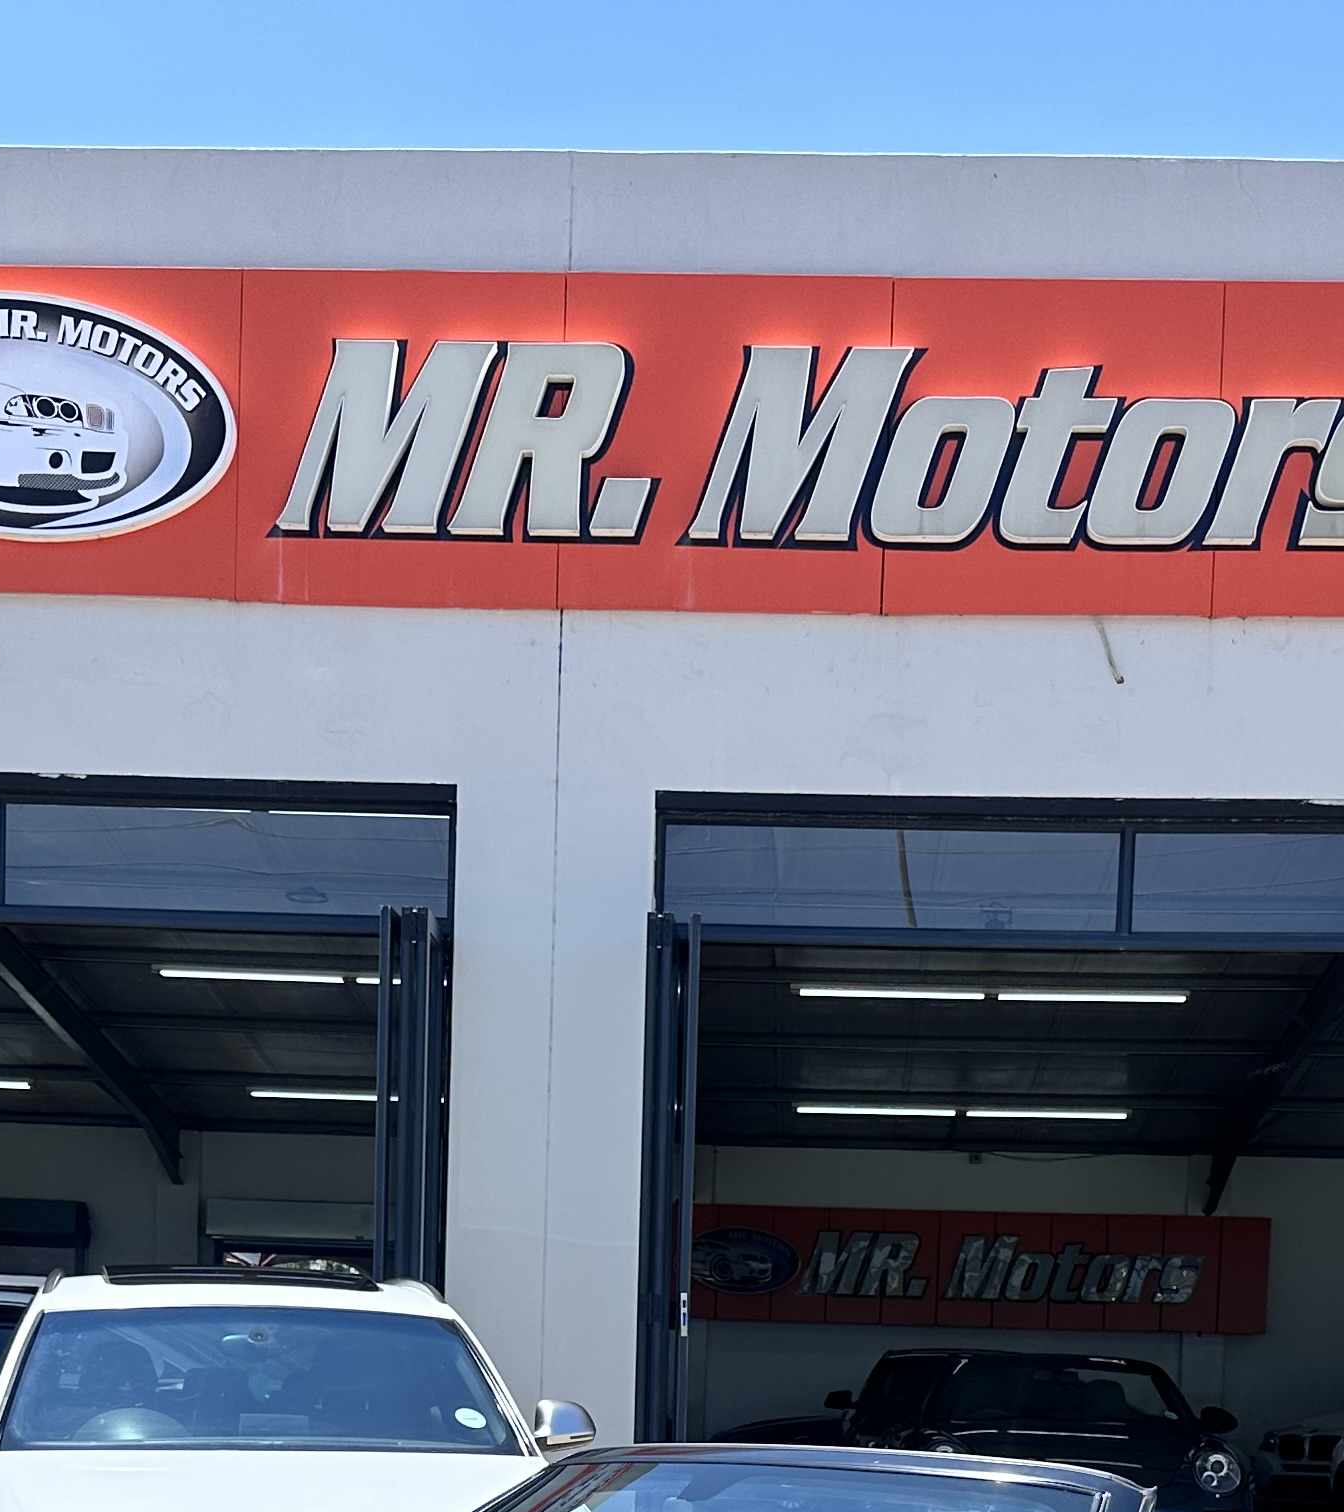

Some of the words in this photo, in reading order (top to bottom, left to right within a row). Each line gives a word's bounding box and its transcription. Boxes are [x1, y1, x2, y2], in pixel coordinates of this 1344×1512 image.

[57, 314, 206, 412] MOTORS
[269, 337, 660, 541] MR.
[796, 1230, 927, 1297] MR.
[943, 1234, 1206, 1304] Motors
